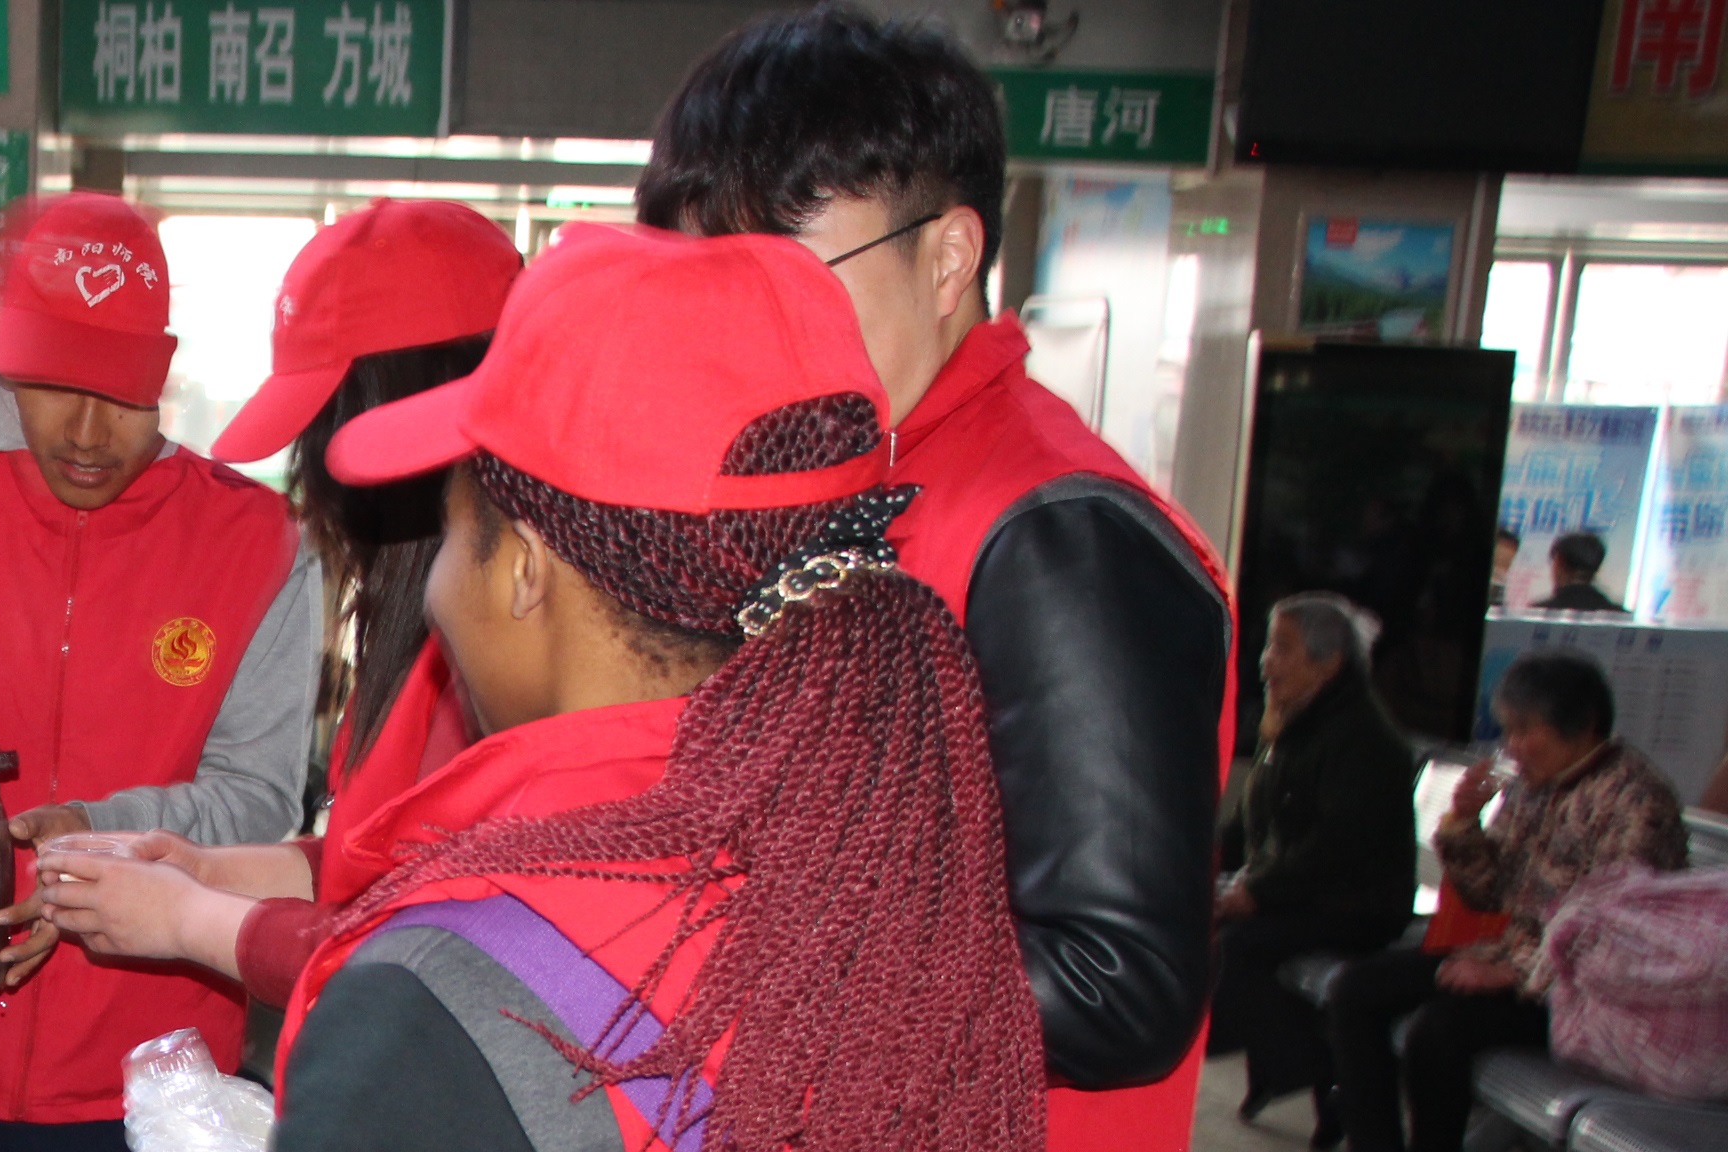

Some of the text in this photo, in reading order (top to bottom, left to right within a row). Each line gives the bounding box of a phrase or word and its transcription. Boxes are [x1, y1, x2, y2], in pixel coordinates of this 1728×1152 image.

[94, 1, 412, 105] 桐柏 南召 方城
[1040, 85, 1161, 148] 唐河
